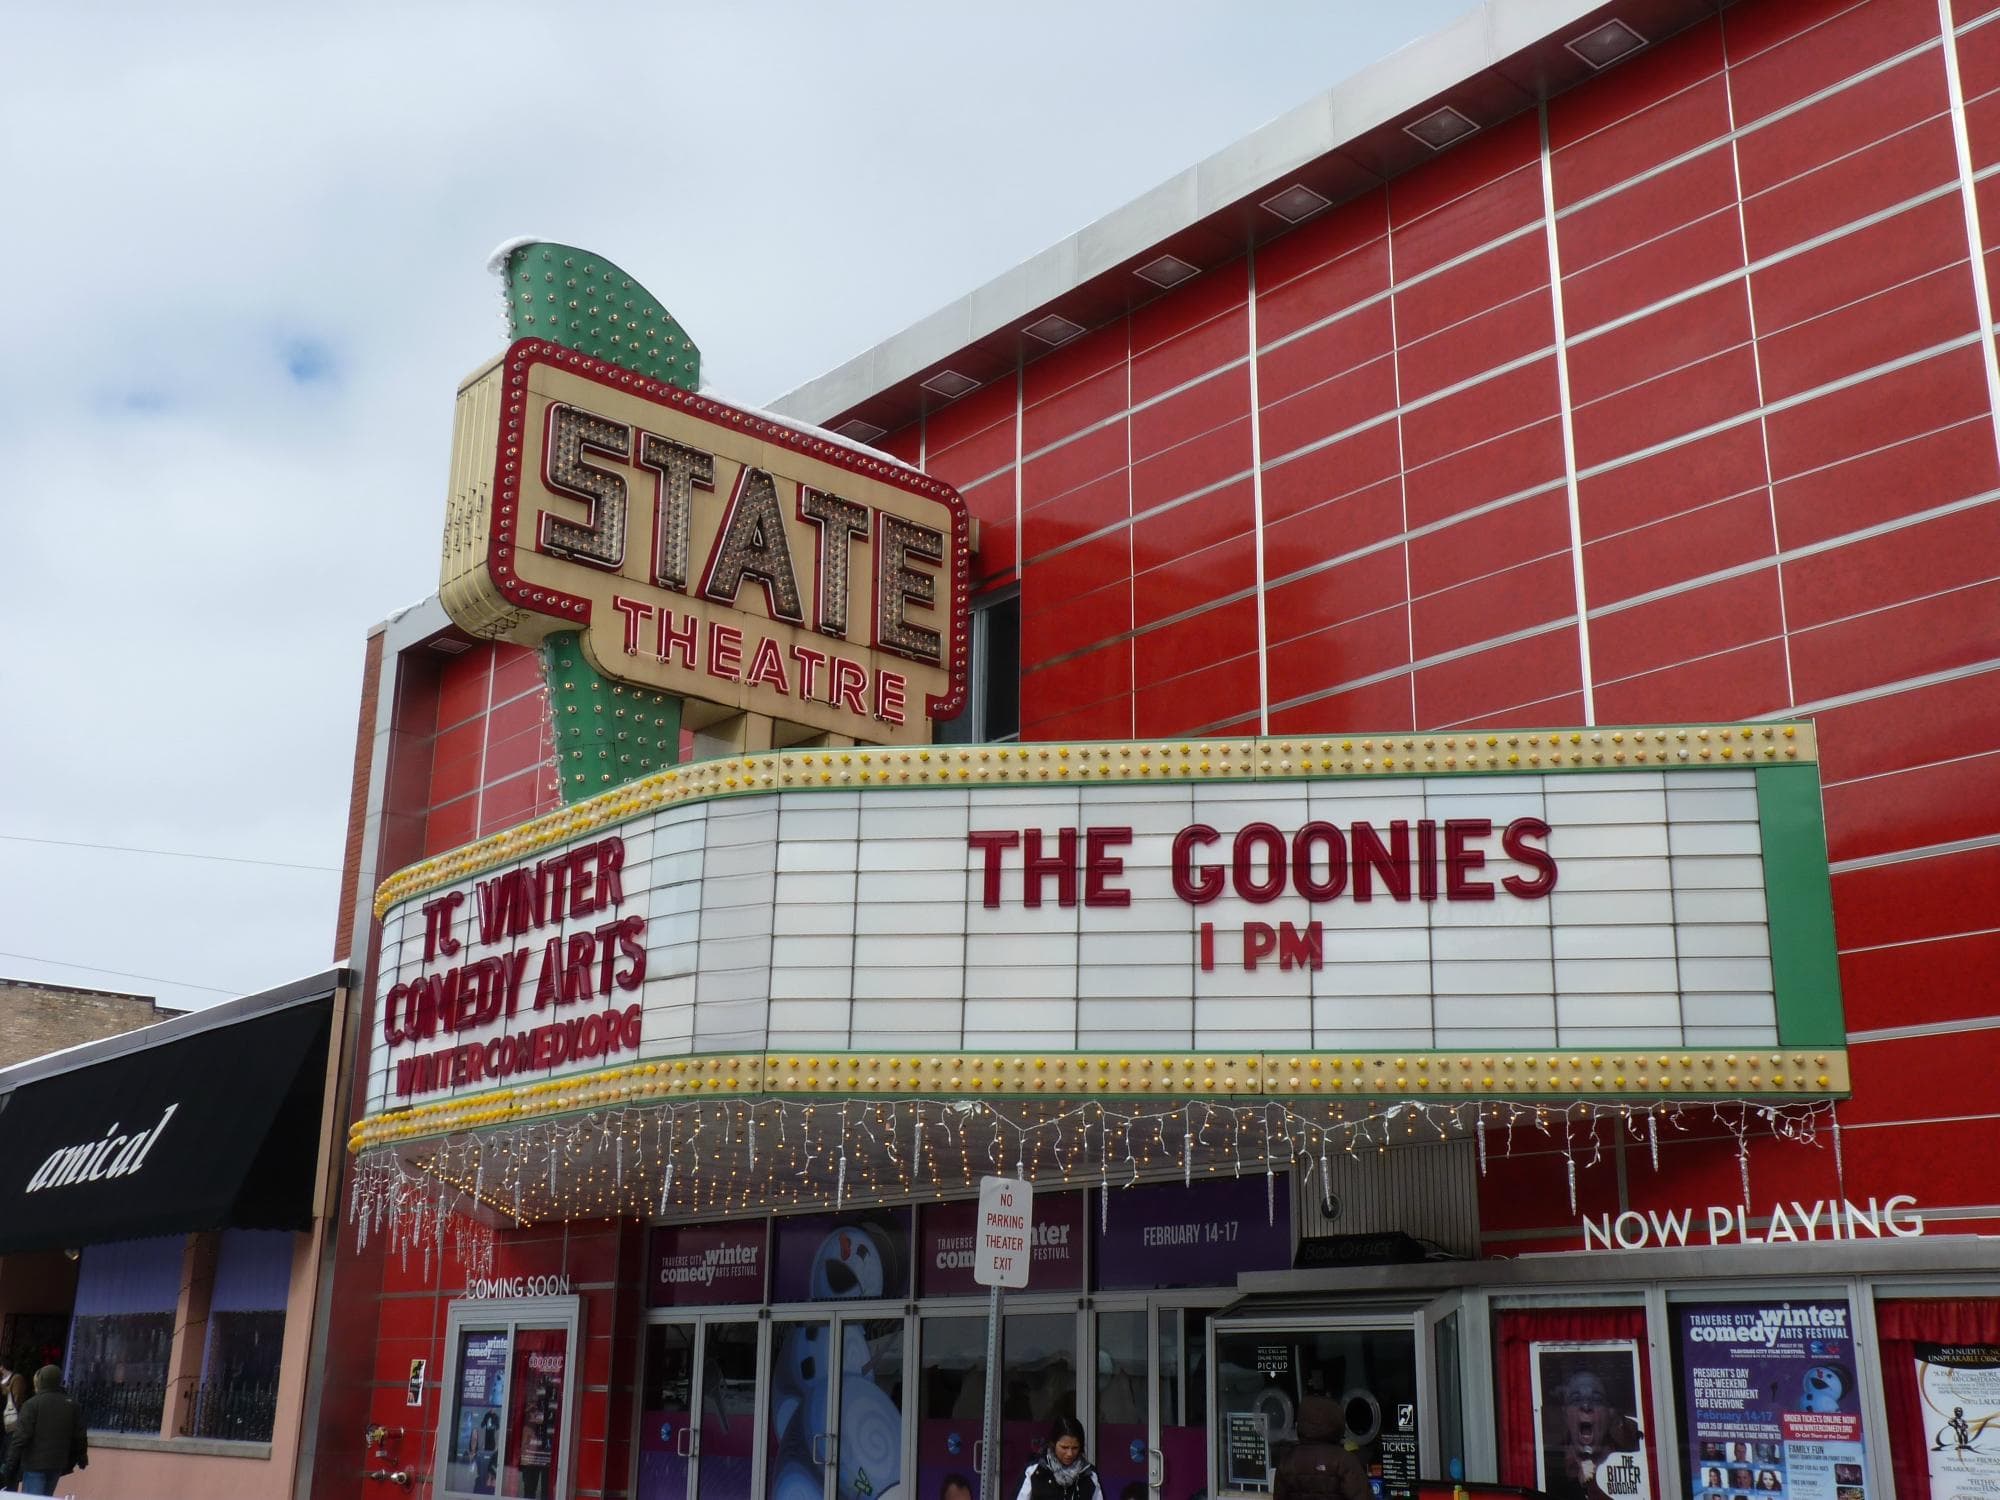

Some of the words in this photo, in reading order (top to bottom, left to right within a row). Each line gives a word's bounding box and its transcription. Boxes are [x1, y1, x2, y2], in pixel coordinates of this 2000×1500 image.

[537, 401, 945, 668] STATE
[613, 595, 906, 726] THEATRE
[968, 826, 1133, 908] THE
[1171, 817, 1558, 905] GOONIES
[423, 890, 464, 963] TC
[476, 836, 625, 946] WINTER
[1243, 921, 1323, 971] PM
[384, 947, 529, 1047] COMEDY
[533, 915, 646, 1010] ARTS
[25, 1102, 179, 1194] amical
[1000, 1193, 1013, 1207] NO
[987, 1213, 1024, 1230] PARKING
[1583, 1208, 1692, 1251] NOW
[1708, 1195, 1924, 1245] PLAYING
[937, 1236, 974, 1250] TRAVERSE
[1031, 1221, 1070, 1246] nter
[986, 1234, 1023, 1251] THEATER
[1143, 1223, 1201, 1247] FEBRUARY
[1205, 1221, 1239, 1243] 14-17
[662, 1256, 688, 1267] TRAVERSE
[690, 1255, 702, 1266] CITY
[705, 1241, 758, 1265] winter
[936, 1250, 975, 1269] com
[1034, 1247, 1070, 1260] FESTIVAL
[994, 1256, 1013, 1271] EXIT
[661, 1260, 716, 1287] comedy
[715, 1266, 729, 1277] ARTS
[731, 1265, 758, 1277] FESTIVAL
[467, 1277, 523, 1299] COMING
[527, 1274, 570, 1297] SOON
[1690, 1315, 1732, 1326] TRAVERSE
[1735, 1315, 1755, 1326] CITY
[1759, 1302, 1846, 1326] winter
[1690, 1320, 1780, 1347] comedy
[1780, 1328, 1803, 1339] ARTS
[1806, 1328, 1849, 1339] FESTIVAL
[1257, 1362, 1288, 1370] PICKUP
[1693, 1368, 1736, 1379] PRESIDENT'S
[1736, 1369, 1749, 1379] DAY
[1694, 1378, 1748, 1389] MEGA-WEEKEND
[1695, 1389, 1704, 1398] OF
[1705, 1389, 1759, 1399] ENTERTAINMENT
[1695, 1399, 1709, 1409] FOR
[1710, 1399, 1745, 1410] EVERYONE
[1696, 1410, 1741, 1423] February
[1744, 1411, 1773, 1421] 14-17
[1783, 1414, 1801, 1422] ORDER
[1802, 1414, 1822, 1423] TICKETS
[1823, 1415, 1842, 1424] ONLINE
[1382, 1442, 1415, 1452] TICKETS
[1789, 1445, 1810, 1454] FAMILY
[1812, 1446, 1824, 1454] FUN
[1621, 1455, 1633, 1467] THE
[1607, 1466, 1640, 1483] BITTER
